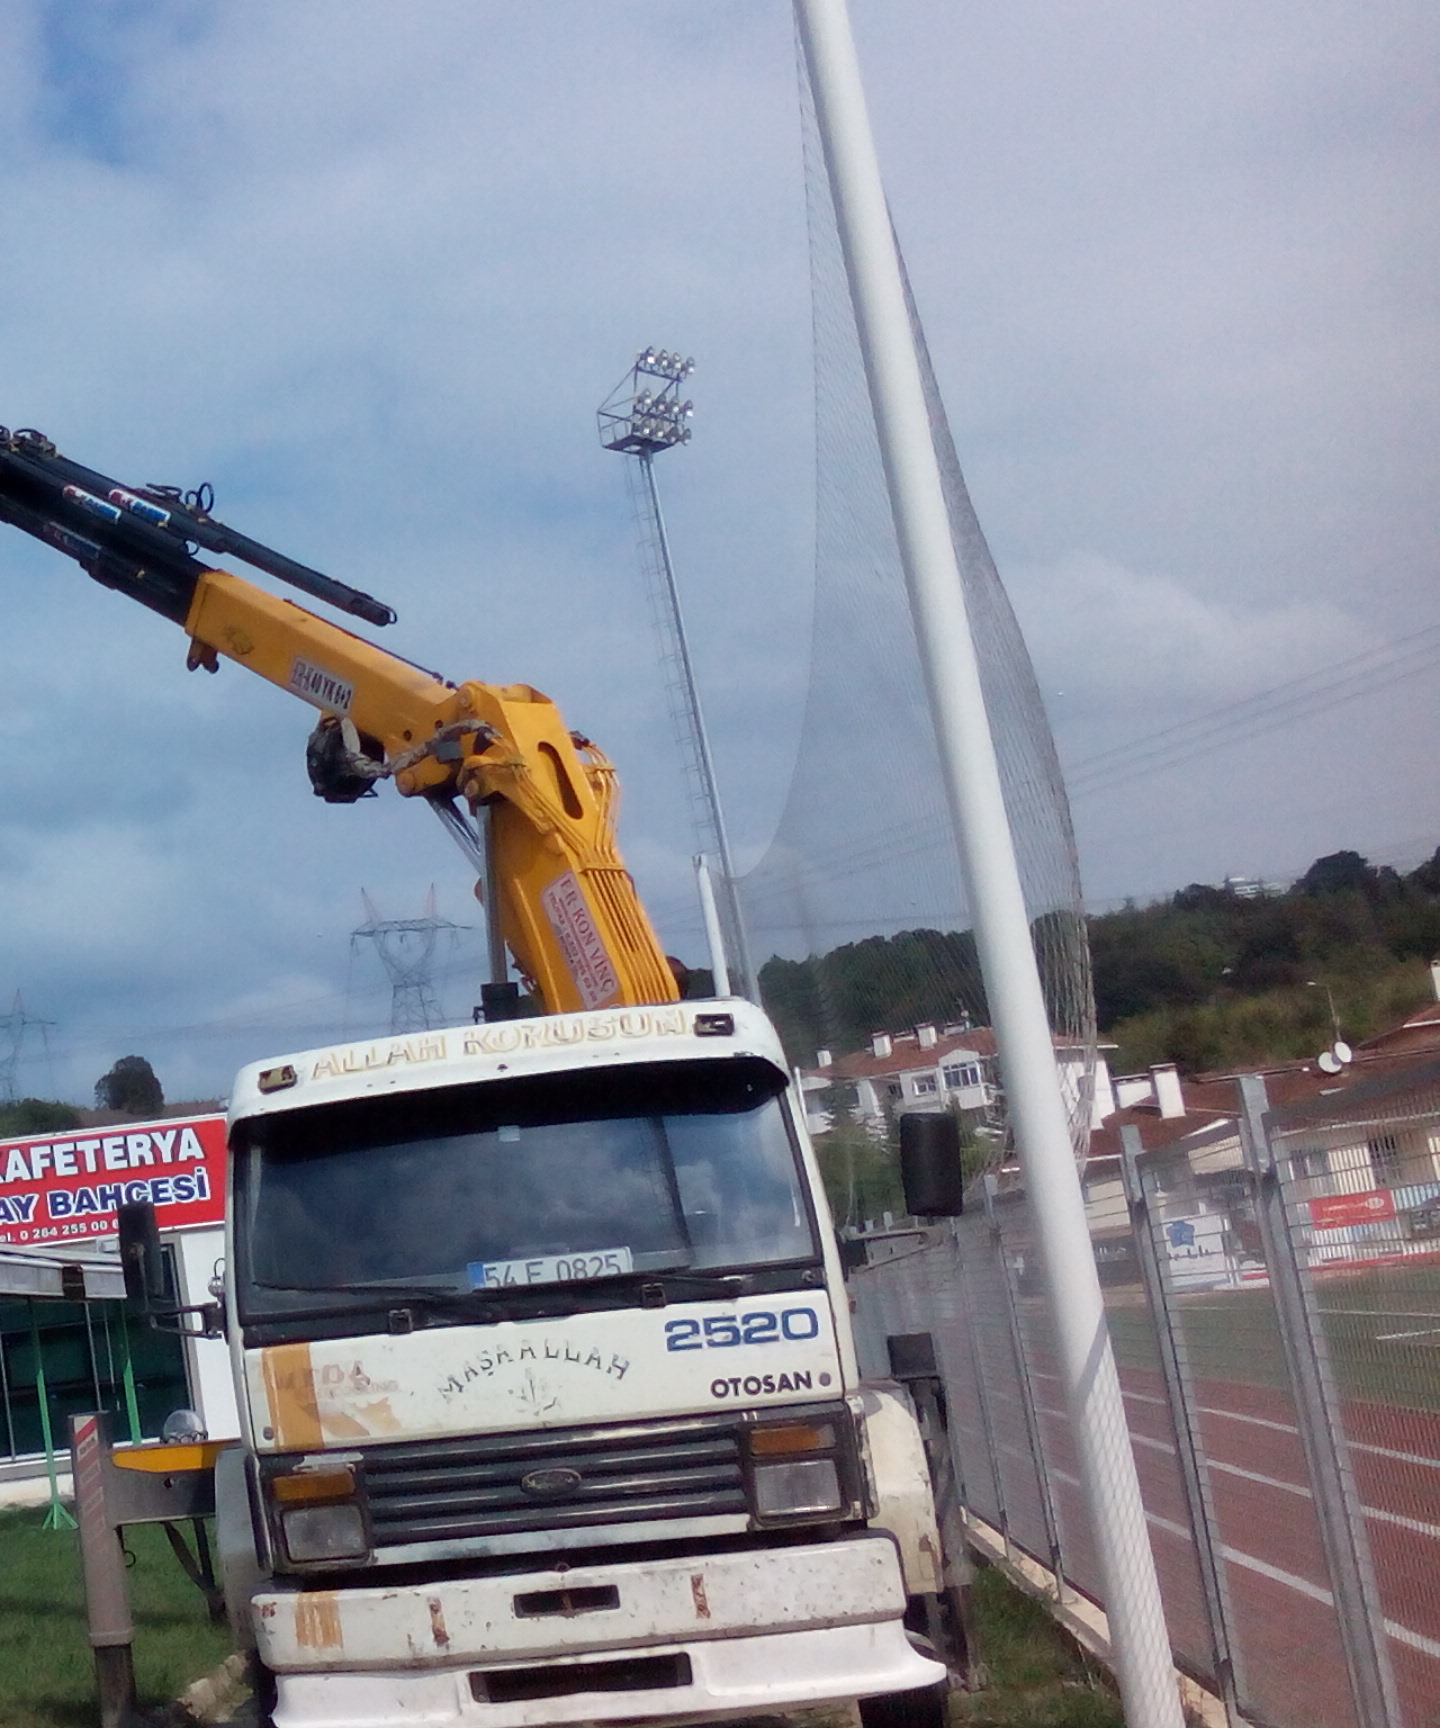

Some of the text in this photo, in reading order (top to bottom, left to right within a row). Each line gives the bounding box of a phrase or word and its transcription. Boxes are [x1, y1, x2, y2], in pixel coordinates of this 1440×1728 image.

[311, 1035, 448, 1080] ALLAH
[664, 1307, 819, 1352] 2520
[711, 1370, 813, 1398] OTOSAN
